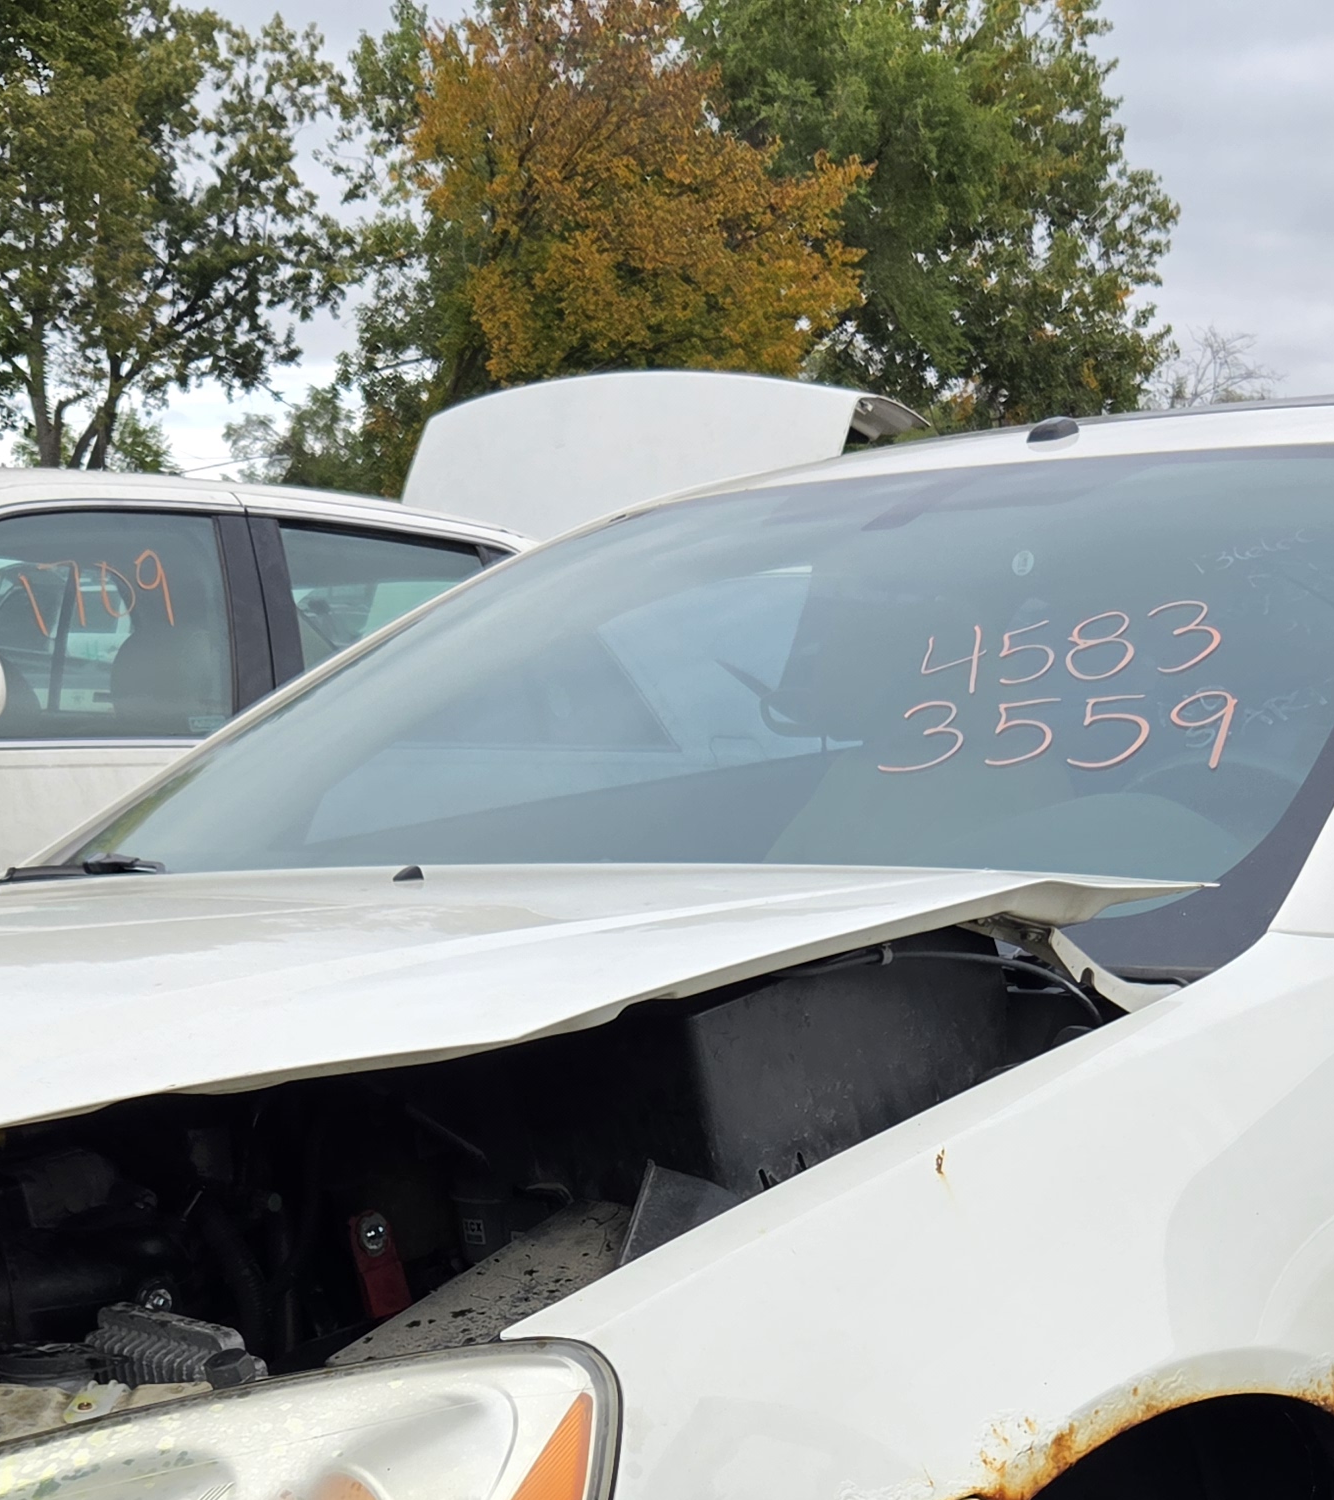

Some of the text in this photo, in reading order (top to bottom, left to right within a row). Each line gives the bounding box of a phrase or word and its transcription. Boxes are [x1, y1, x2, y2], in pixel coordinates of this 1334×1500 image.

[18, 549, 175, 637] 1709
[920, 600, 1222, 694] 4583
[877, 690, 1238, 772] 3559
